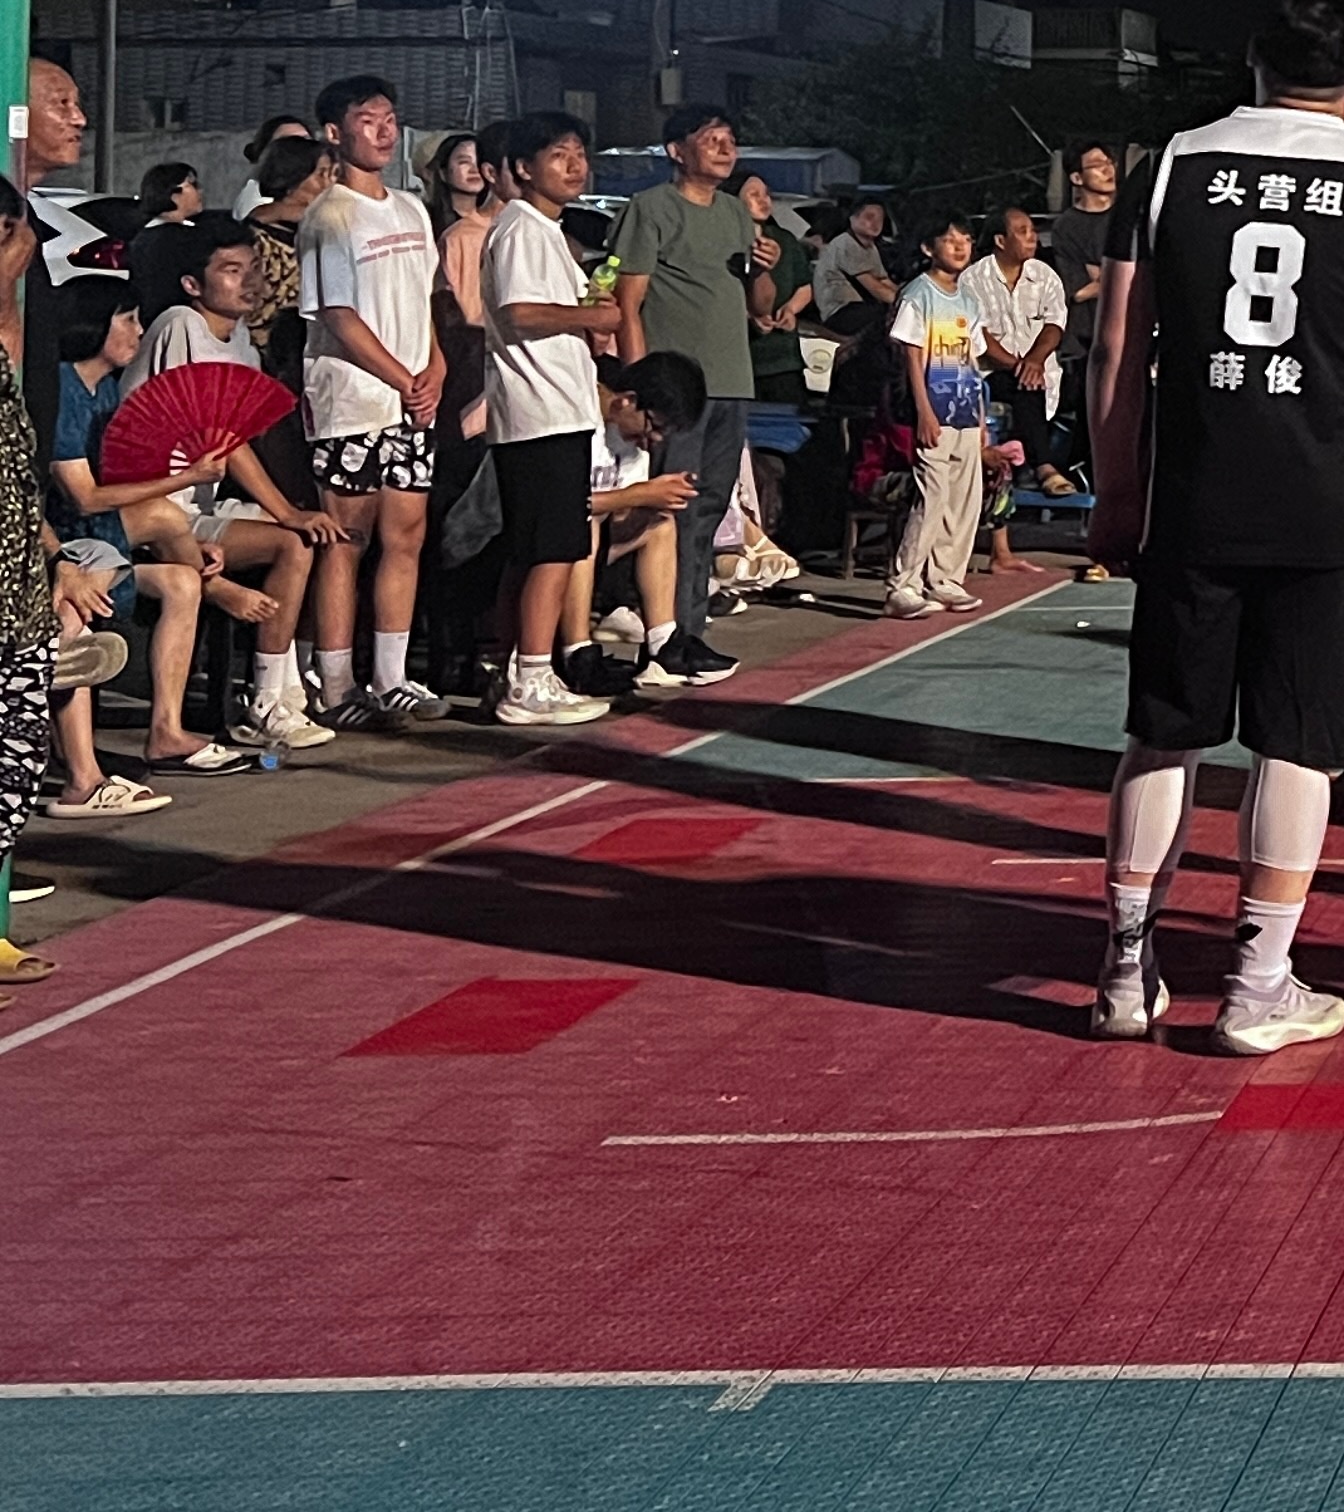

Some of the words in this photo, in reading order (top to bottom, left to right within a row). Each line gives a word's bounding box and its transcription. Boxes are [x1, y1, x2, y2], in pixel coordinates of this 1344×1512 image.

[1207, 169, 1344, 217] 头营组
[1223, 221, 1306, 347] 8
